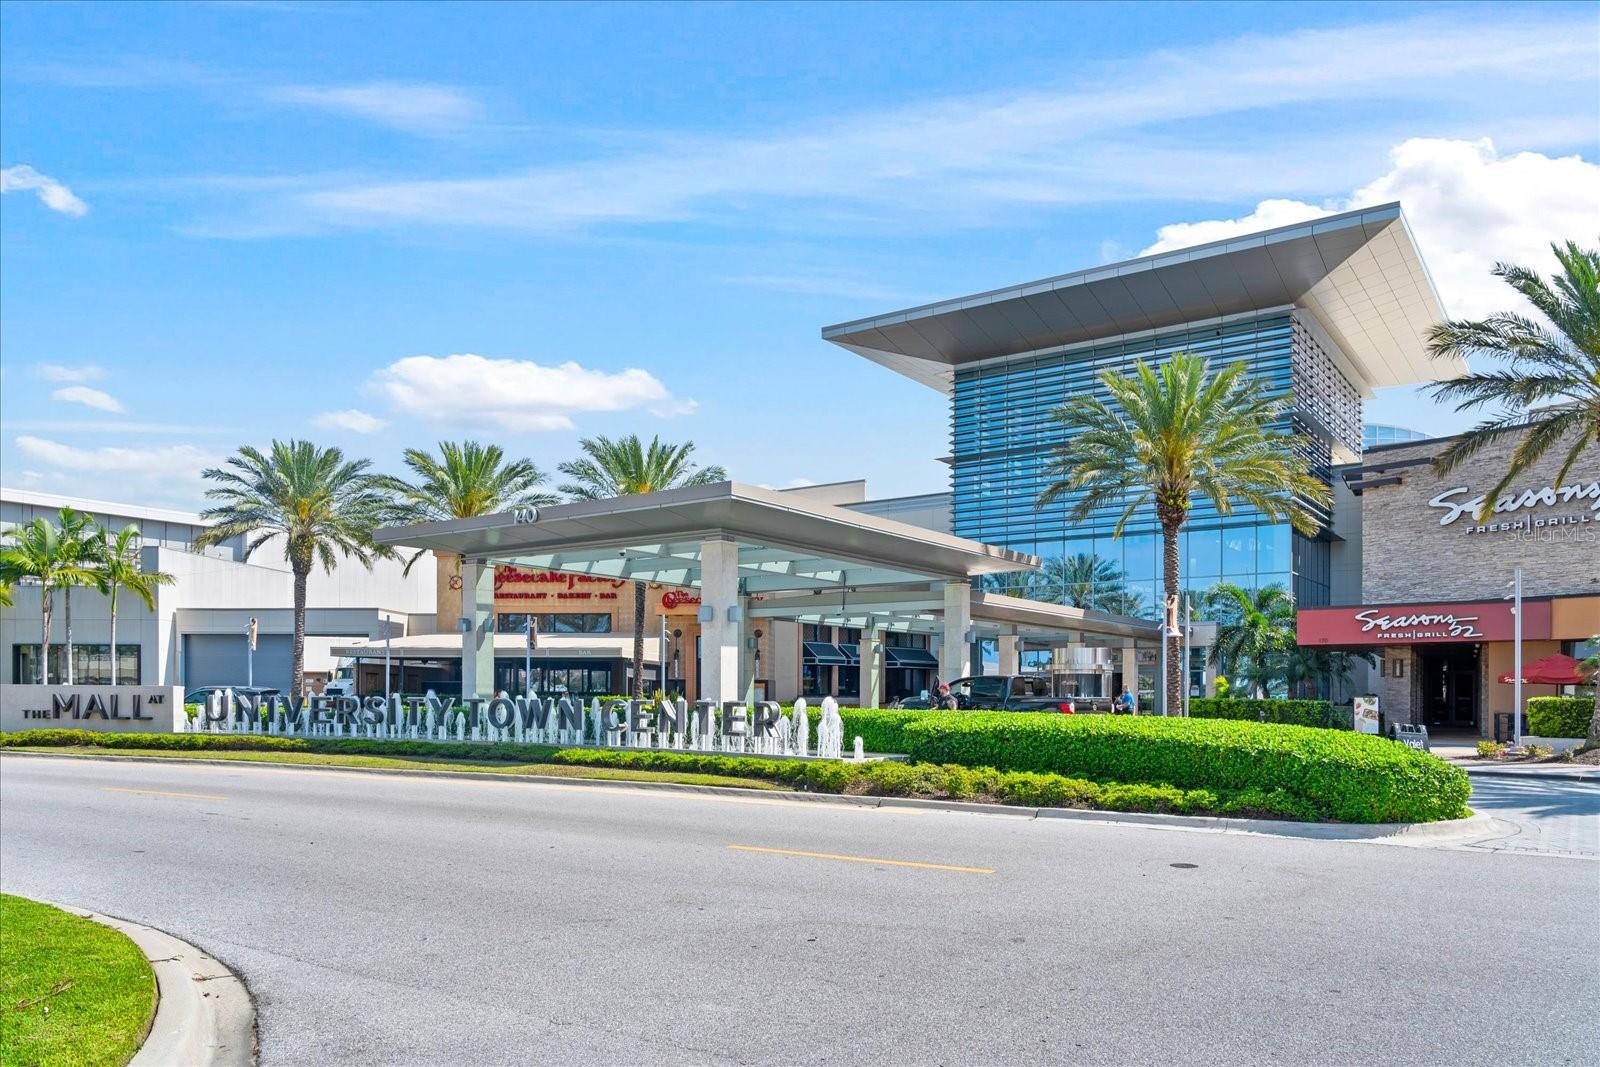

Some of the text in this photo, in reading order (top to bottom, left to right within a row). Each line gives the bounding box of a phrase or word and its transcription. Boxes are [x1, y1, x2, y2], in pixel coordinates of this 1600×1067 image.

[1466, 515, 1590, 535] FRESH GRILL
[1355, 609, 1478, 632] Seasons
[1448, 621, 1483, 637] 52
[22, 693, 782, 738] THE MALL AT UNIVERSITY TOWN CENTER
